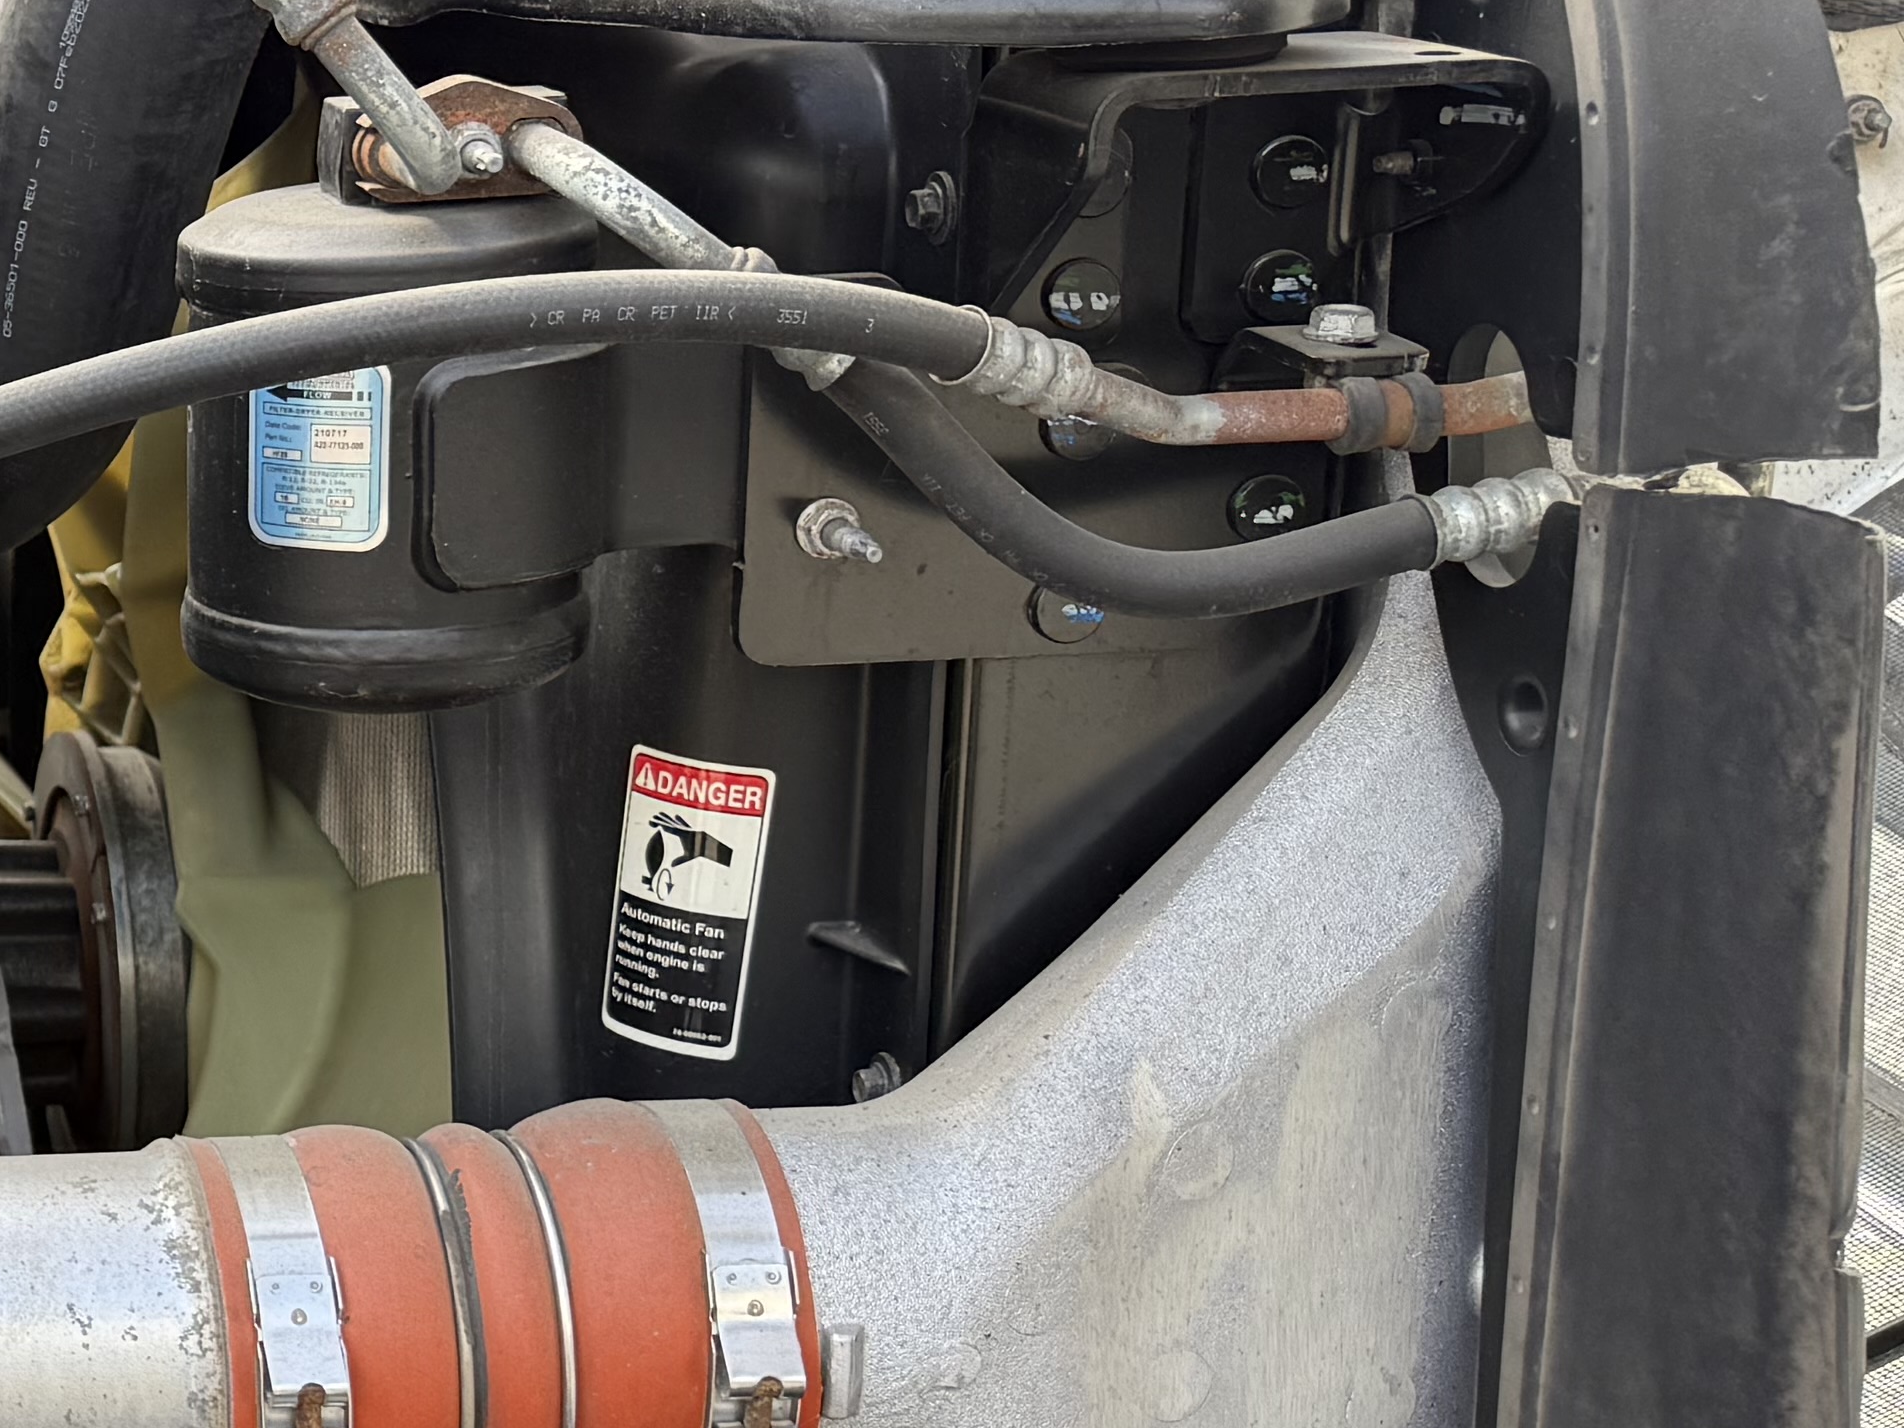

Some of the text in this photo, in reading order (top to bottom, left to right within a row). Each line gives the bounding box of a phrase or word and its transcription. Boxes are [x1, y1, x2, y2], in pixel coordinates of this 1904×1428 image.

[547, 307, 565, 326] CR
[582, 307, 601, 324] PA
[617, 305, 636, 322] CR
[651, 304, 676, 321] PET
[303, 391, 332, 399] FLOW
[656, 773, 763, 811] DANGER
[620, 901, 725, 940] Automatic Fan
[617, 938, 705, 972] when engine is
[619, 923, 725, 960] Keep hands clear
[612, 986, 657, 1014] by itself.
[613, 972, 727, 1015] Fan starts or stops
